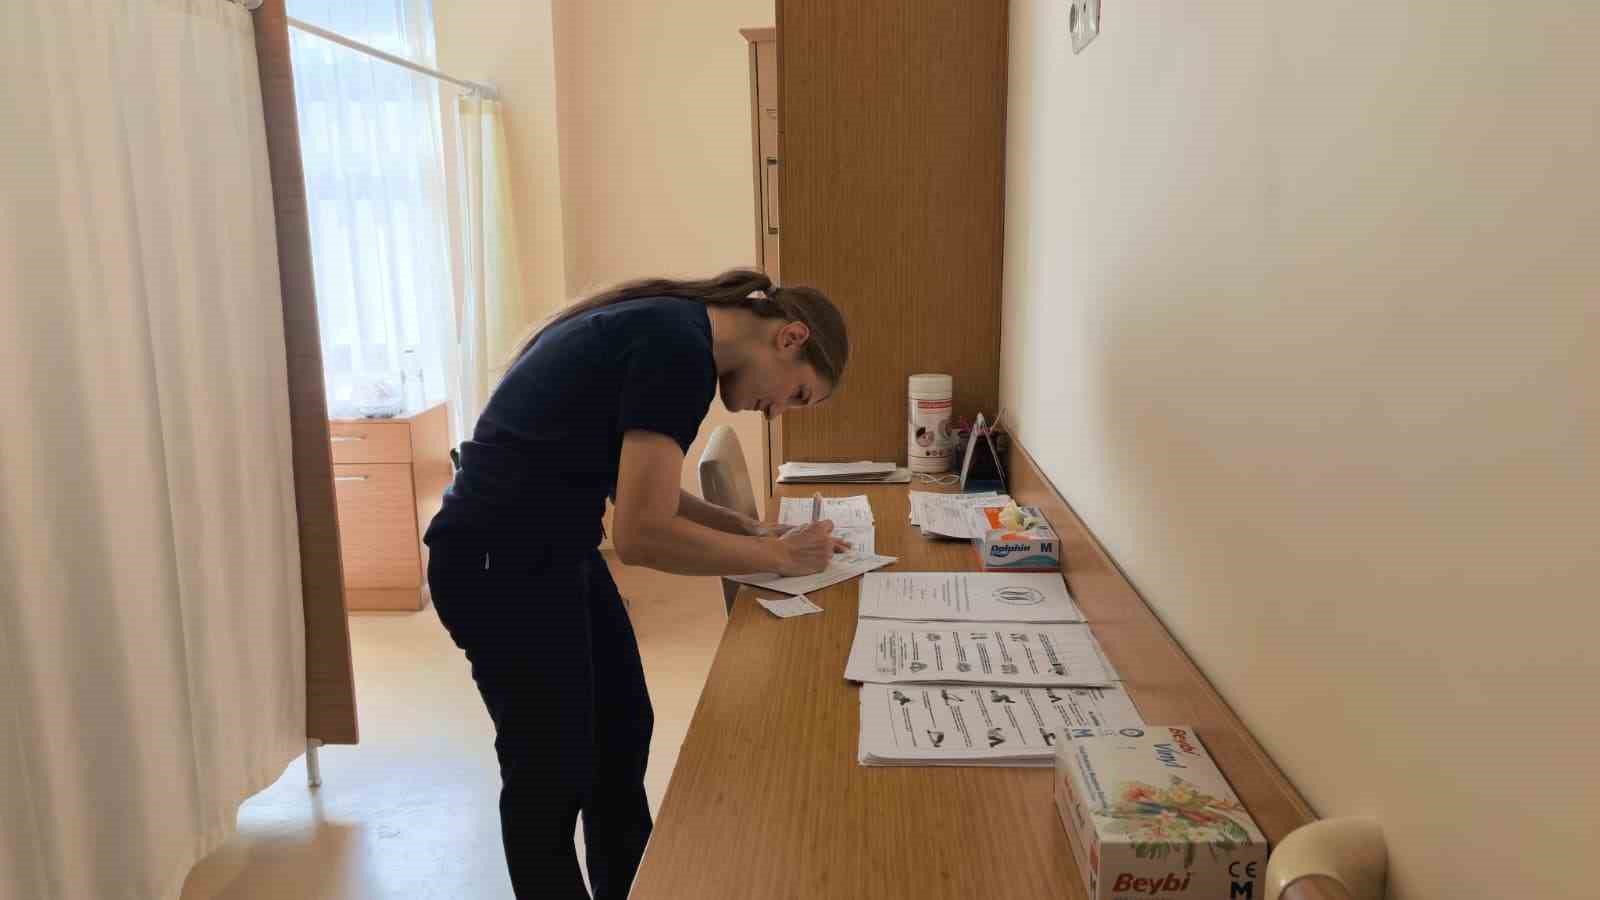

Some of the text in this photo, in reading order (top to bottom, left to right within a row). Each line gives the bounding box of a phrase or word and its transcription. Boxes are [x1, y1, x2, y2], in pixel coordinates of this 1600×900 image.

[1041, 543, 1053, 552] M
[1228, 861, 1257, 878] CE
[1111, 871, 1193, 896] Beybi
[1231, 882, 1253, 900] M
